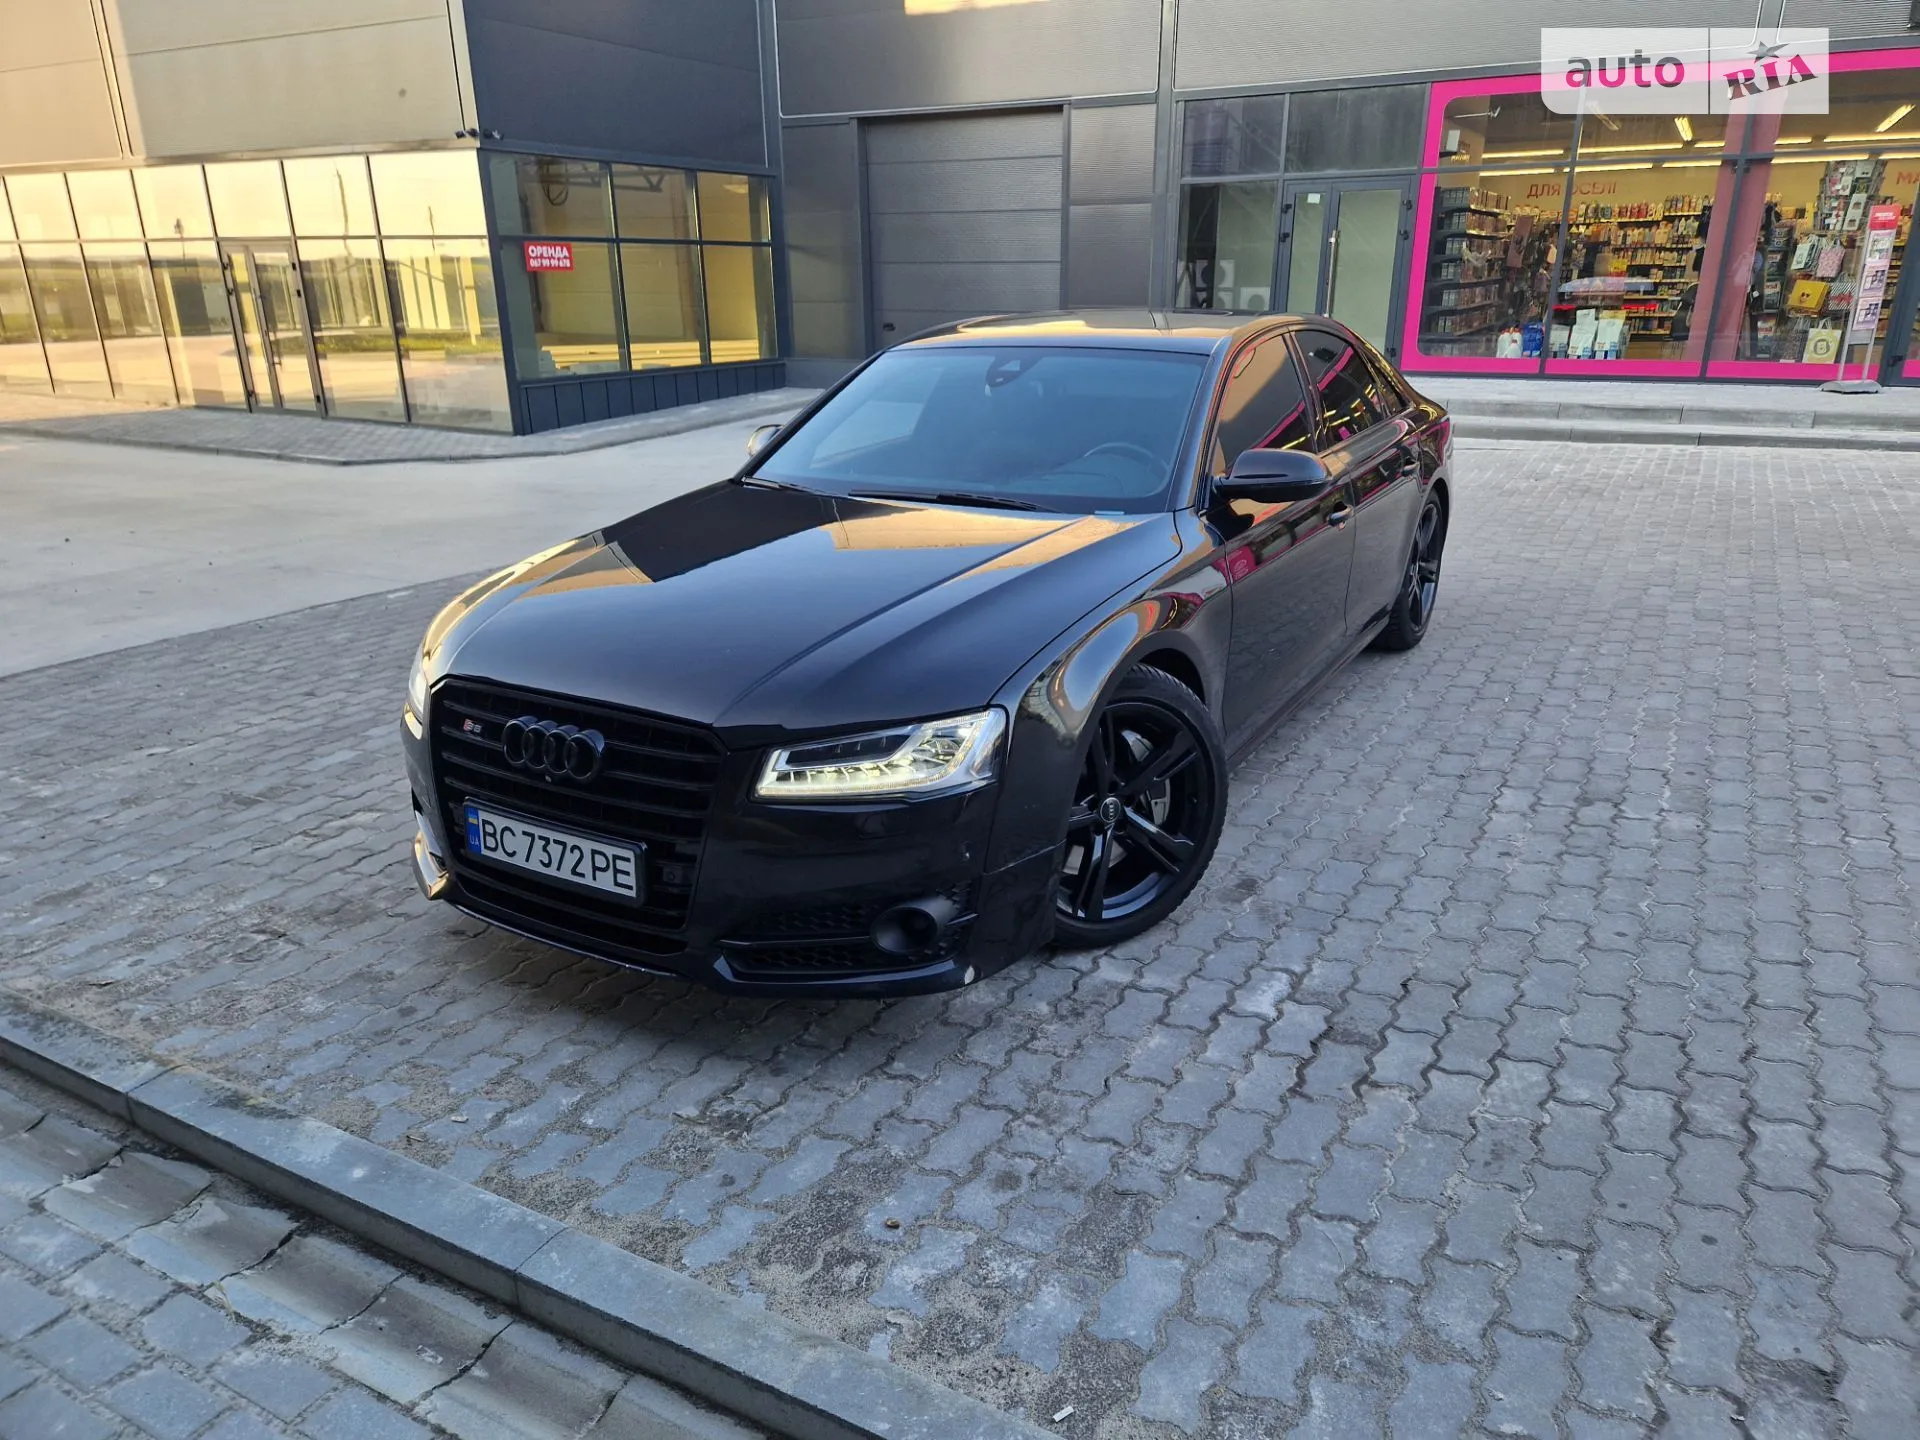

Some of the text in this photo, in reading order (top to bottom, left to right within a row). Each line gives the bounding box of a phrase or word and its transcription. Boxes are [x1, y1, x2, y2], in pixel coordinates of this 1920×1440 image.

[1526, 183, 1561, 199] ДЛЯ
[528, 245, 570, 258] ОРЕНДА
[469, 836, 481, 847] UA
